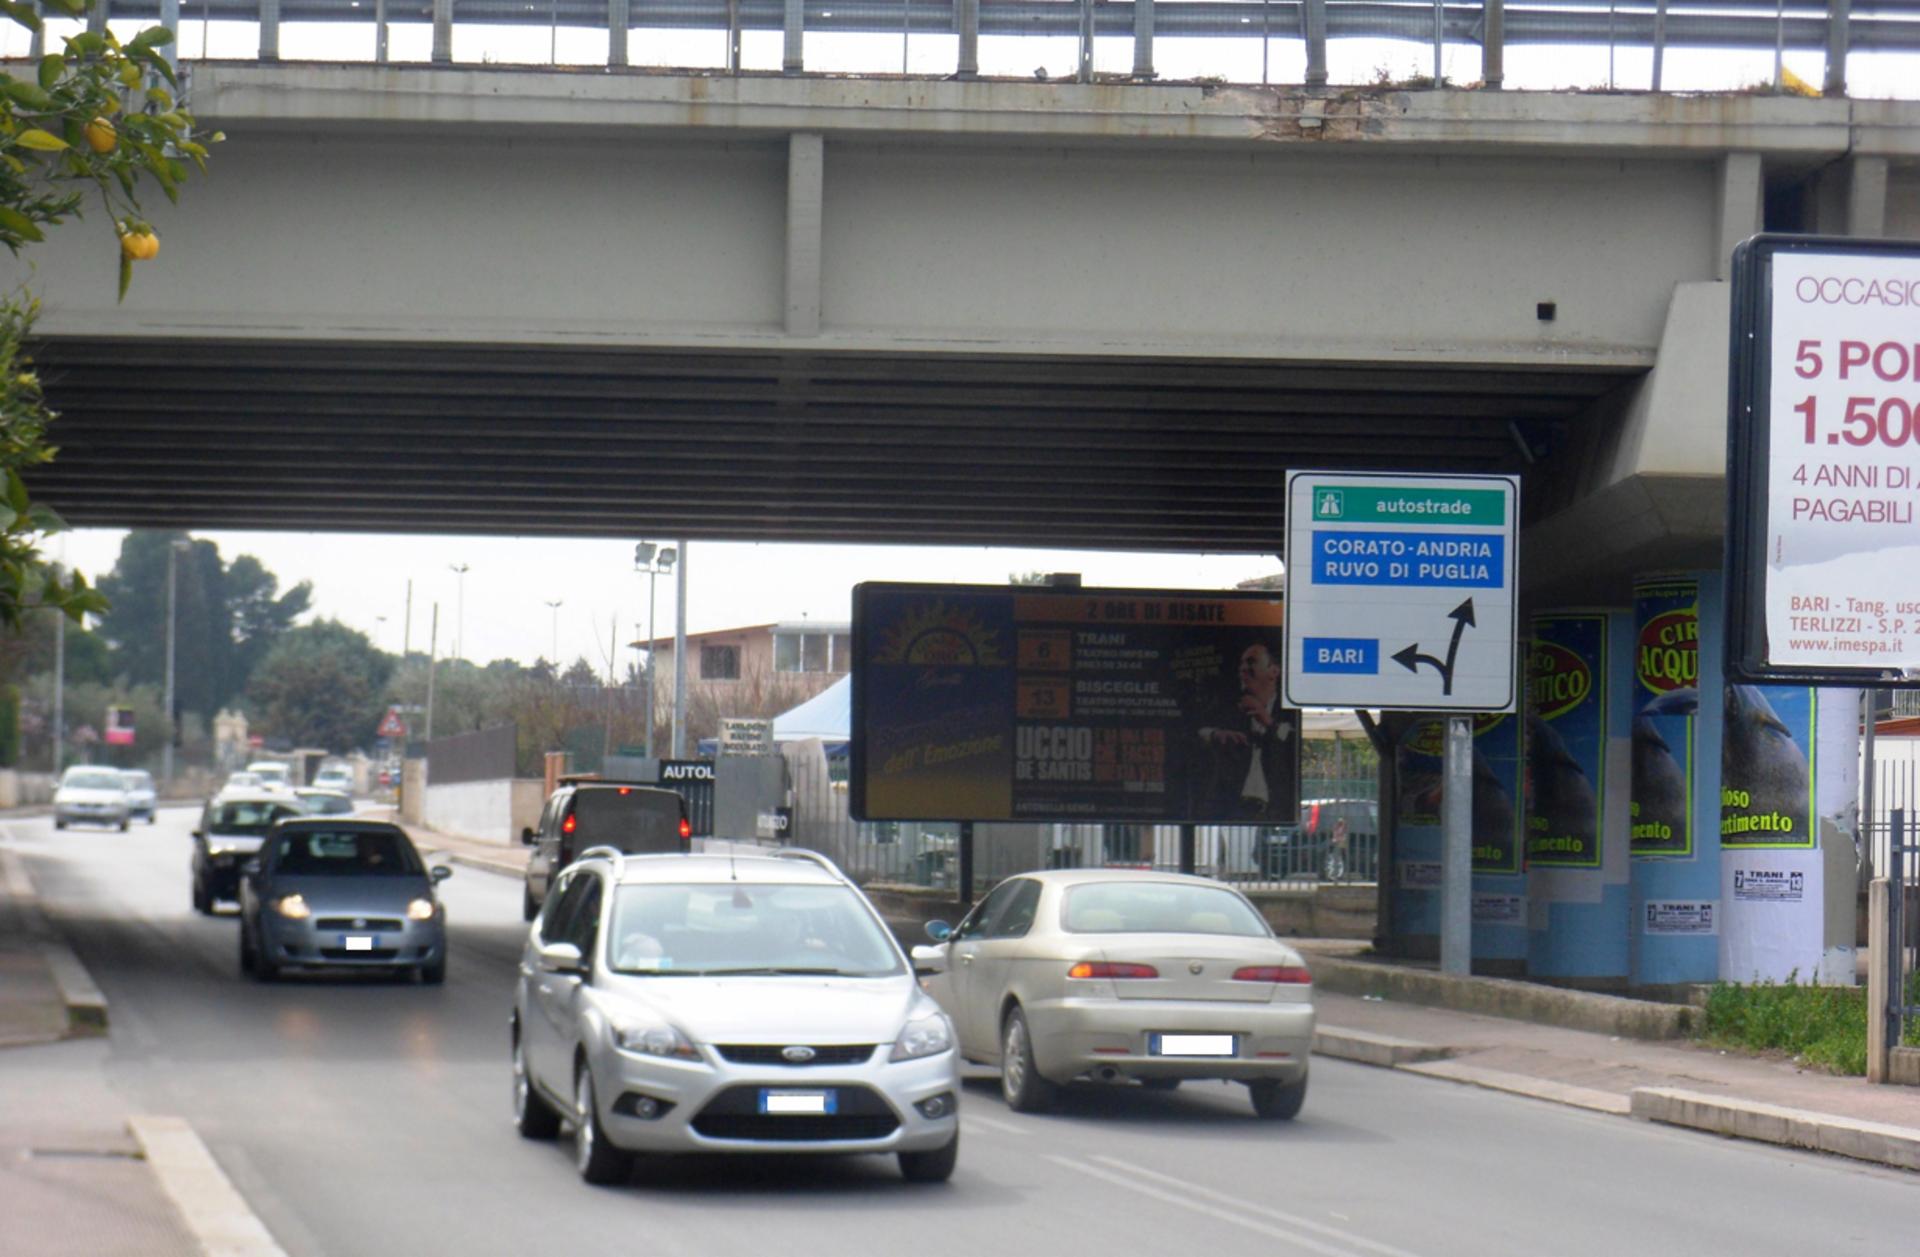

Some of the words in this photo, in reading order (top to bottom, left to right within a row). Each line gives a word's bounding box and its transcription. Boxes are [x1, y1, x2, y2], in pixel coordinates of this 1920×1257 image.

[1794, 340, 1823, 379] 5
[1839, 340, 1920, 383] PO
[1793, 395, 1920, 448] 1.50
[1792, 463, 1807, 486] 4
[1813, 464, 1877, 488] ANNI
[1886, 465, 1910, 489] DI
[1376, 498, 1472, 515] autostrade
[1793, 498, 1912, 524] PAGABILI
[1325, 562, 1379, 578] RUVO
[1389, 562, 1409, 578] DI
[1419, 563, 1489, 580] PUGLIA
[1791, 596, 1829, 612] BARI
[1846, 597, 1889, 618] Tang.
[1790, 616, 1861, 633] TERLIZZI
[1879, 619, 1907, 634] S.P.
[1077, 632, 1125, 646] TRANI
[1789, 636, 1903, 656] www.imespa.it
[1317, 648, 1364, 664] BARI
[1076, 681, 1160, 694] BISCEGLIE
[1016, 726, 1092, 760] UCCIO
[664, 765, 715, 779] AUTOL
[1016, 761, 1034, 780] DE
[1038, 761, 1092, 780] SANTIS
